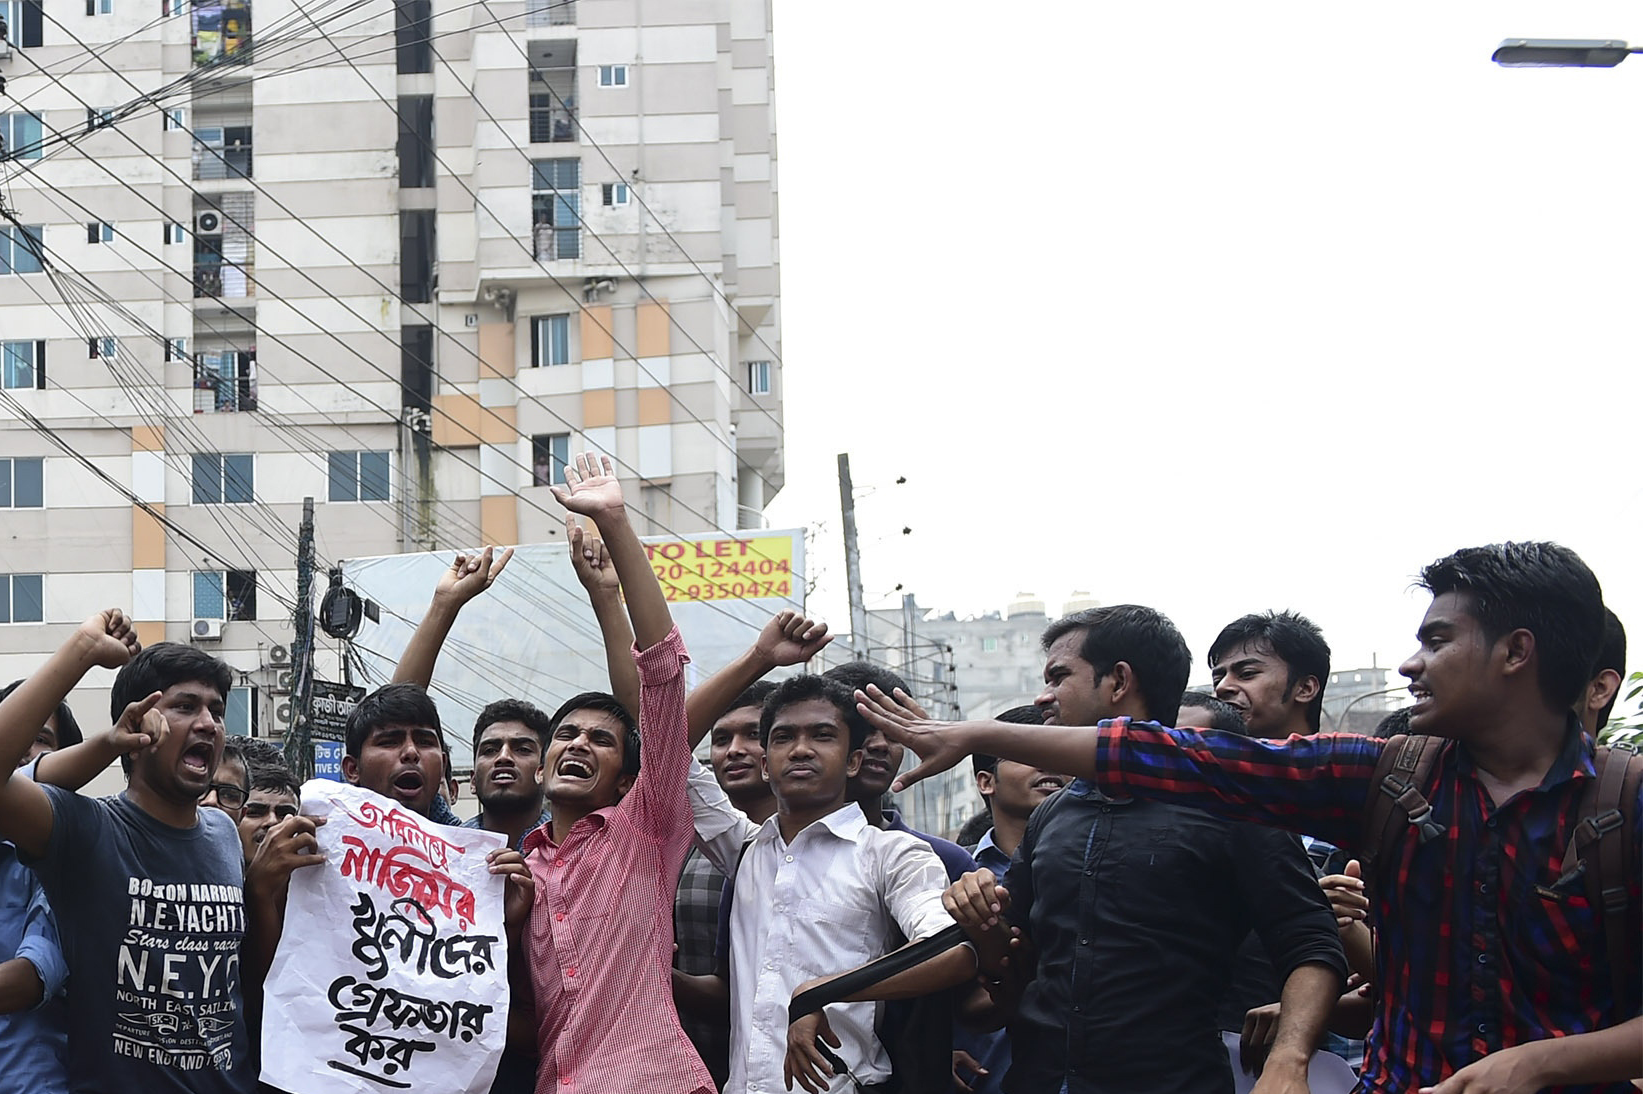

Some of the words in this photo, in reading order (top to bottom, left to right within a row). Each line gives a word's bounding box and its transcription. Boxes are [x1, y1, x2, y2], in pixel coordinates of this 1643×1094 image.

[645, 543, 685, 561] TO
[695, 539, 754, 558] LET
[123, 929, 170, 950] Stars
[175, 936, 209, 951] class
[116, 989, 157, 1010] NORTH
[166, 1000, 195, 1016] EAST
[327, 975, 494, 1043] গ্রেফতার
[114, 1039, 143, 1059] NEW
[338, 1023, 436, 1075] কর
